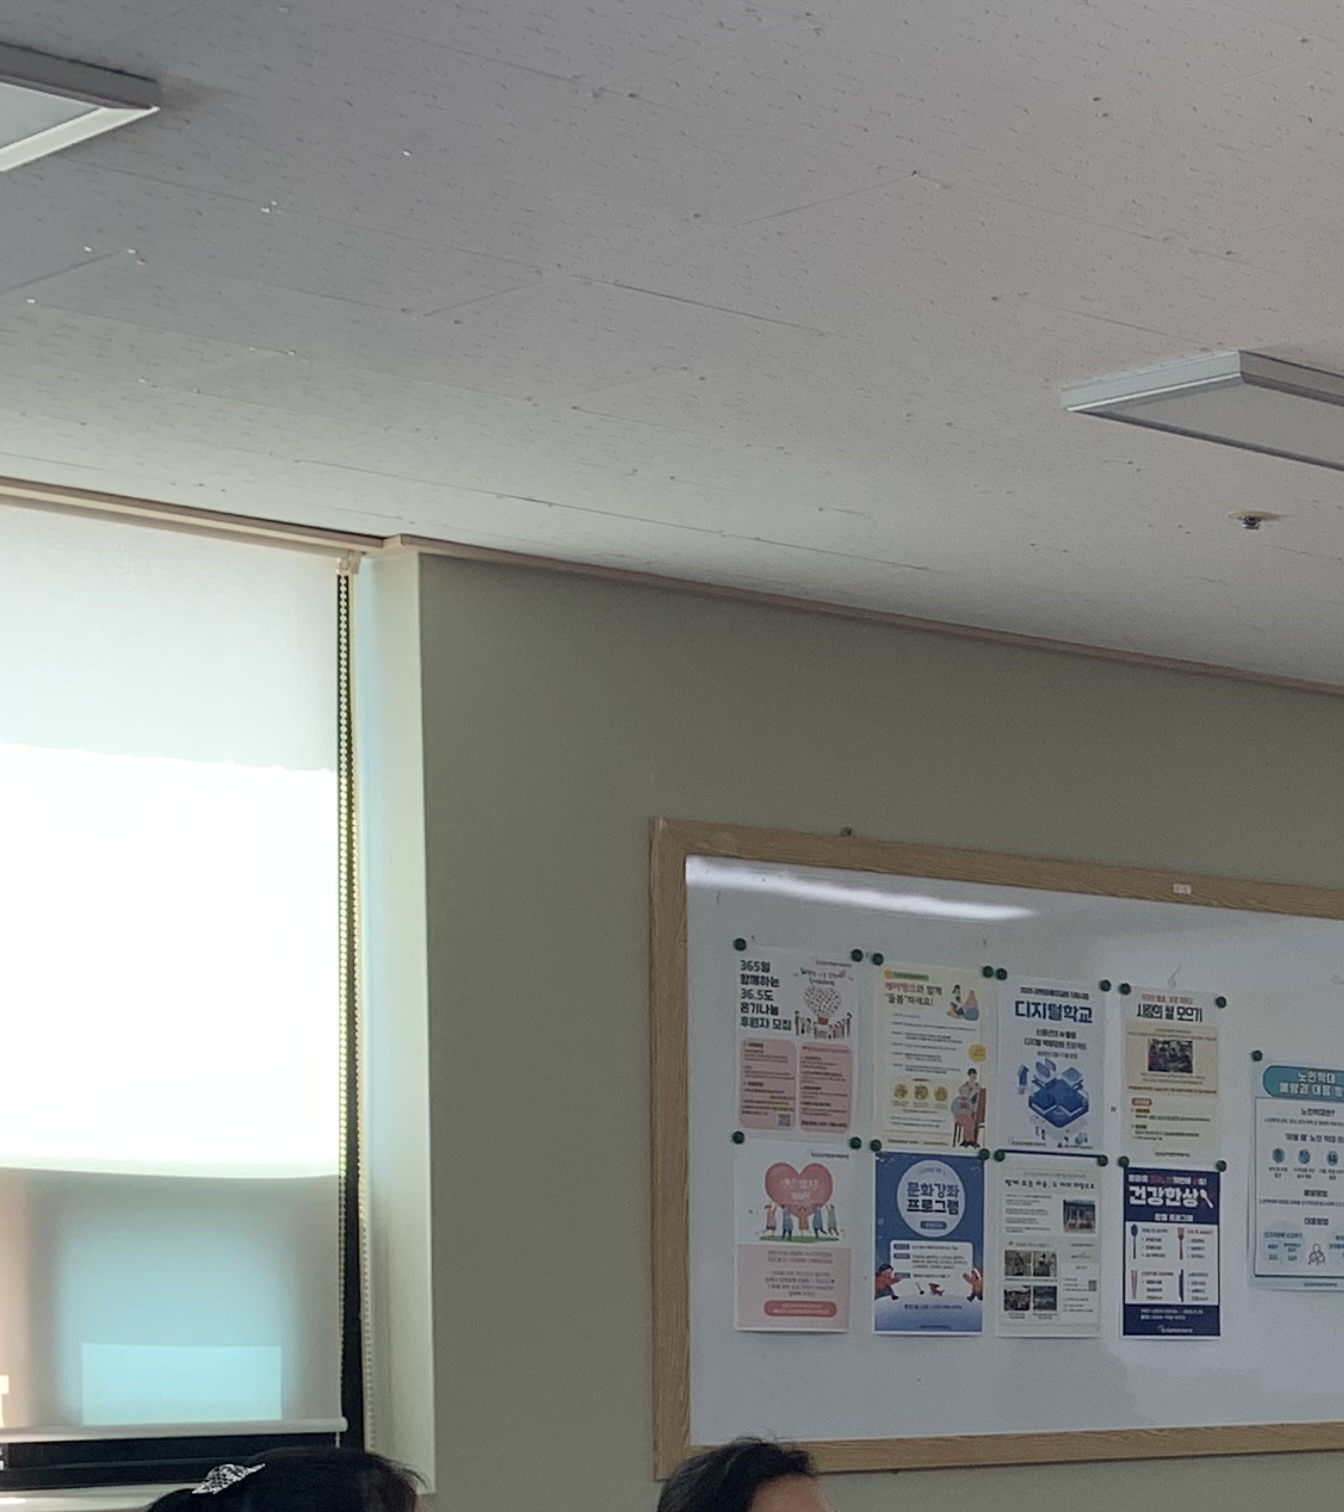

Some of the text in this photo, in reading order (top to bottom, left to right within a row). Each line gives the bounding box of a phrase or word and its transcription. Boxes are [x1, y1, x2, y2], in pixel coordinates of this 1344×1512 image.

[740, 989, 774, 1002] 36.5도
[1015, 1000, 1093, 1024] 디지털학교
[906, 1181, 960, 1199] 문화강좌
[1129, 1186, 1198, 1208] 건강한상
[906, 1199, 959, 1216] 프로그램
